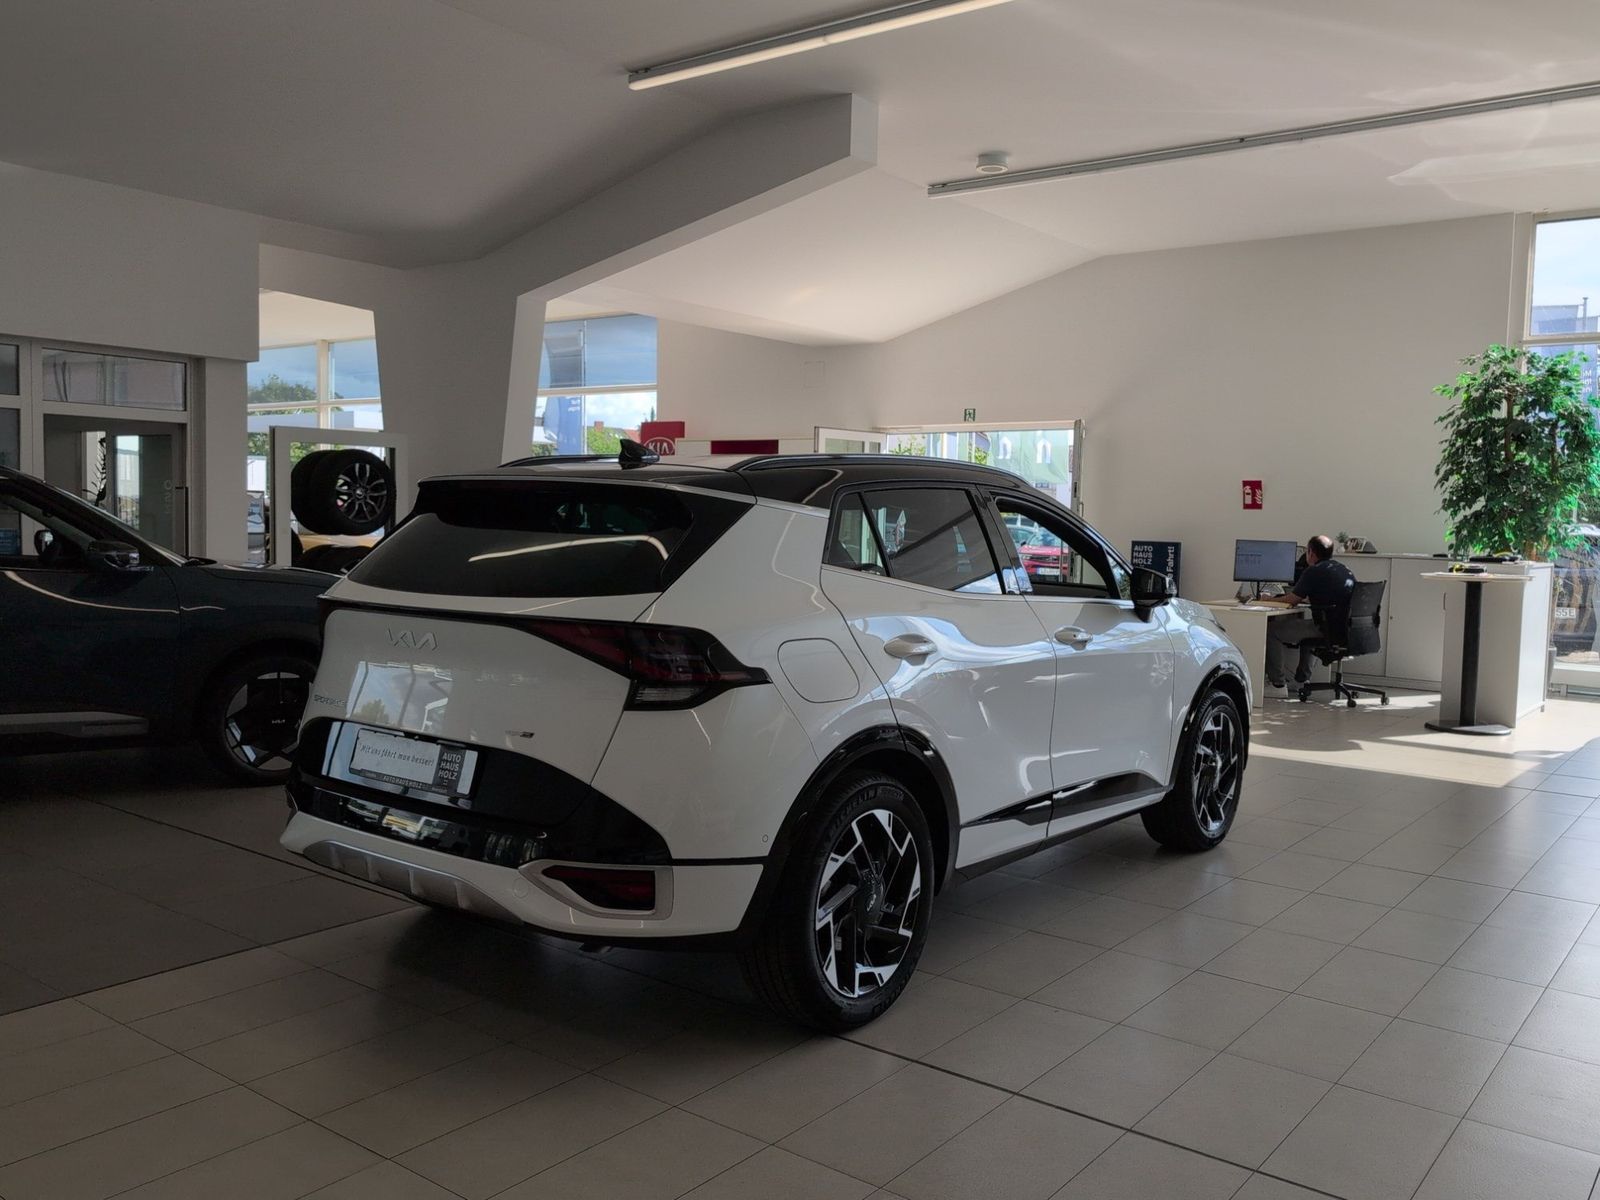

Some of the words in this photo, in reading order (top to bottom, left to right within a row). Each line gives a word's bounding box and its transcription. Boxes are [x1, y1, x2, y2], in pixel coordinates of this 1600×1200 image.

[648, 441, 669, 454] KIA
[386, 624, 439, 651] KIA
[442, 752, 462, 762] AUTO
[440, 761, 460, 771] HAUS
[438, 769, 458, 780] HOLZ
